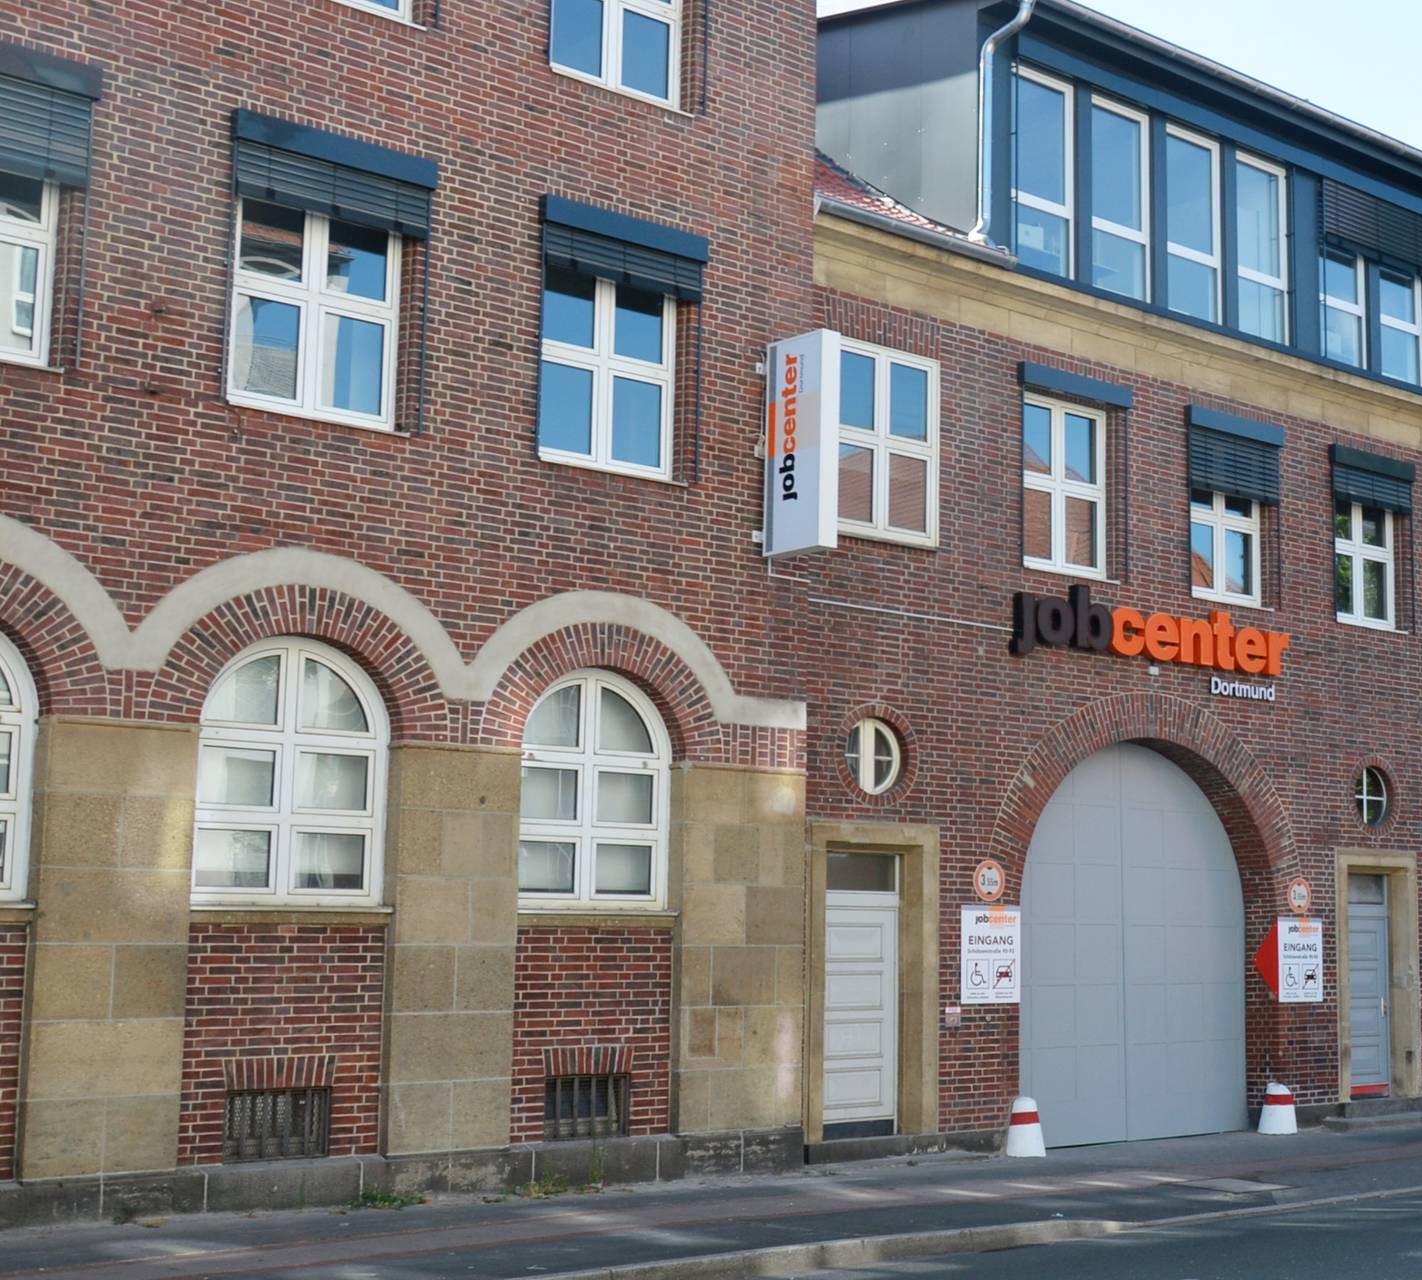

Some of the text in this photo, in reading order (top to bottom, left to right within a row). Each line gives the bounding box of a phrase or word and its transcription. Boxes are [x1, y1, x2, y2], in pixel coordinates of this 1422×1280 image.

[779, 353, 798, 501] jobcenter
[1009, 584, 1290, 676] jobcenter
[1210, 676, 1276, 701] Dortmund
[975, 913, 1017, 924] jobcenter
[968, 935, 1014, 945] EINGANG
[1283, 943, 1318, 952] EINGANG
